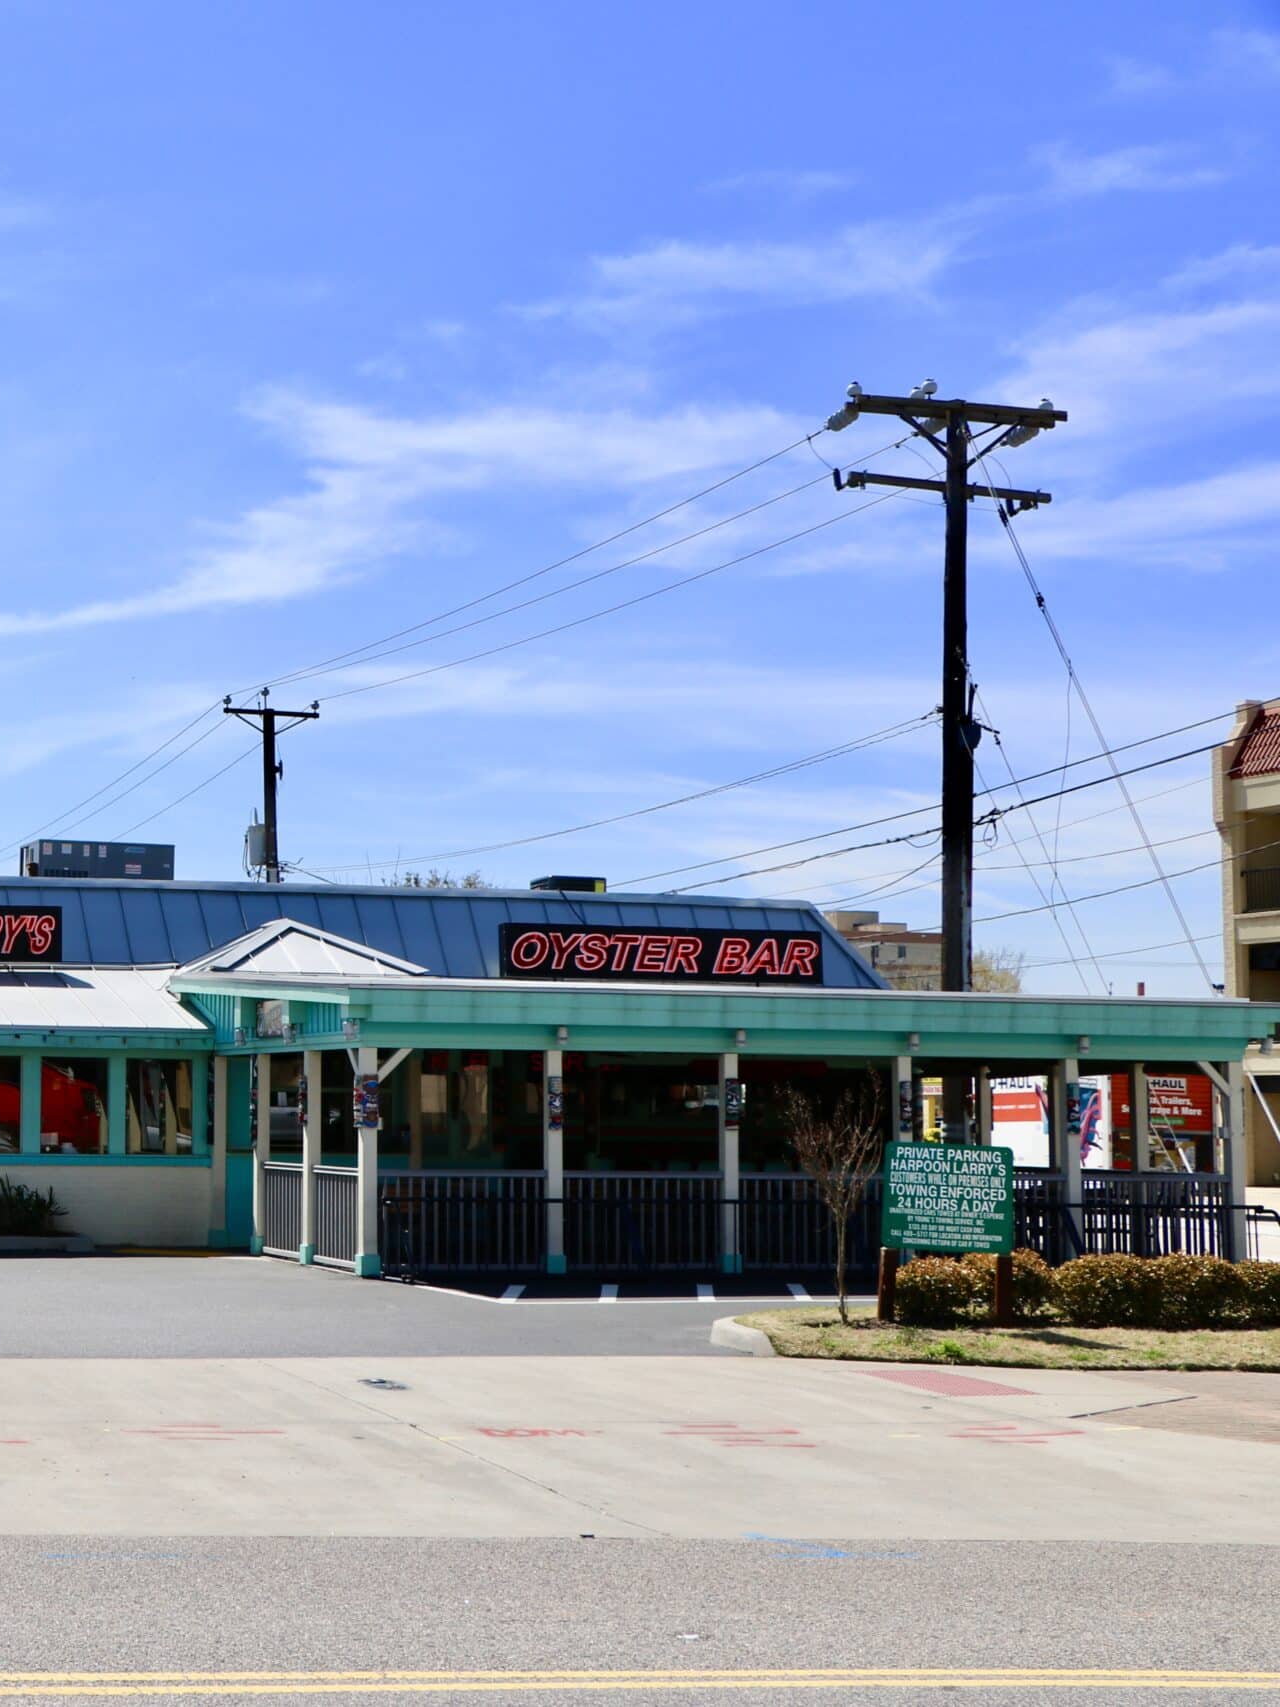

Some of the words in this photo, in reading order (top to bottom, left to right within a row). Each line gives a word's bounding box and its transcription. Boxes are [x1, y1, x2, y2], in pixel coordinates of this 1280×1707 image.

[511, 932, 702, 974] OYSTER
[712, 938, 818, 976] BAR
[1181, 1106, 1202, 1116] More
[897, 1147, 944, 1160] PRIVATE
[947, 1149, 1002, 1163] PARKING
[890, 1159, 950, 1173] HARPOON
[954, 1162, 1006, 1176] LARRY'S
[890, 1172, 926, 1184] CUSTOMERS
[928, 1174, 946, 1185] WHILE
[949, 1174, 956, 1186] ON
[958, 1174, 990, 1187] PREMISES
[990, 1176, 1006, 1188] ONLY
[889, 1184, 937, 1197] TOWING
[940, 1187, 1006, 1200] ENFORCED
[898, 1197, 911, 1208] 24
[915, 1198, 958, 1211] HOURS
[961, 1200, 969, 1212] A
[973, 1201, 996, 1212] DAY
